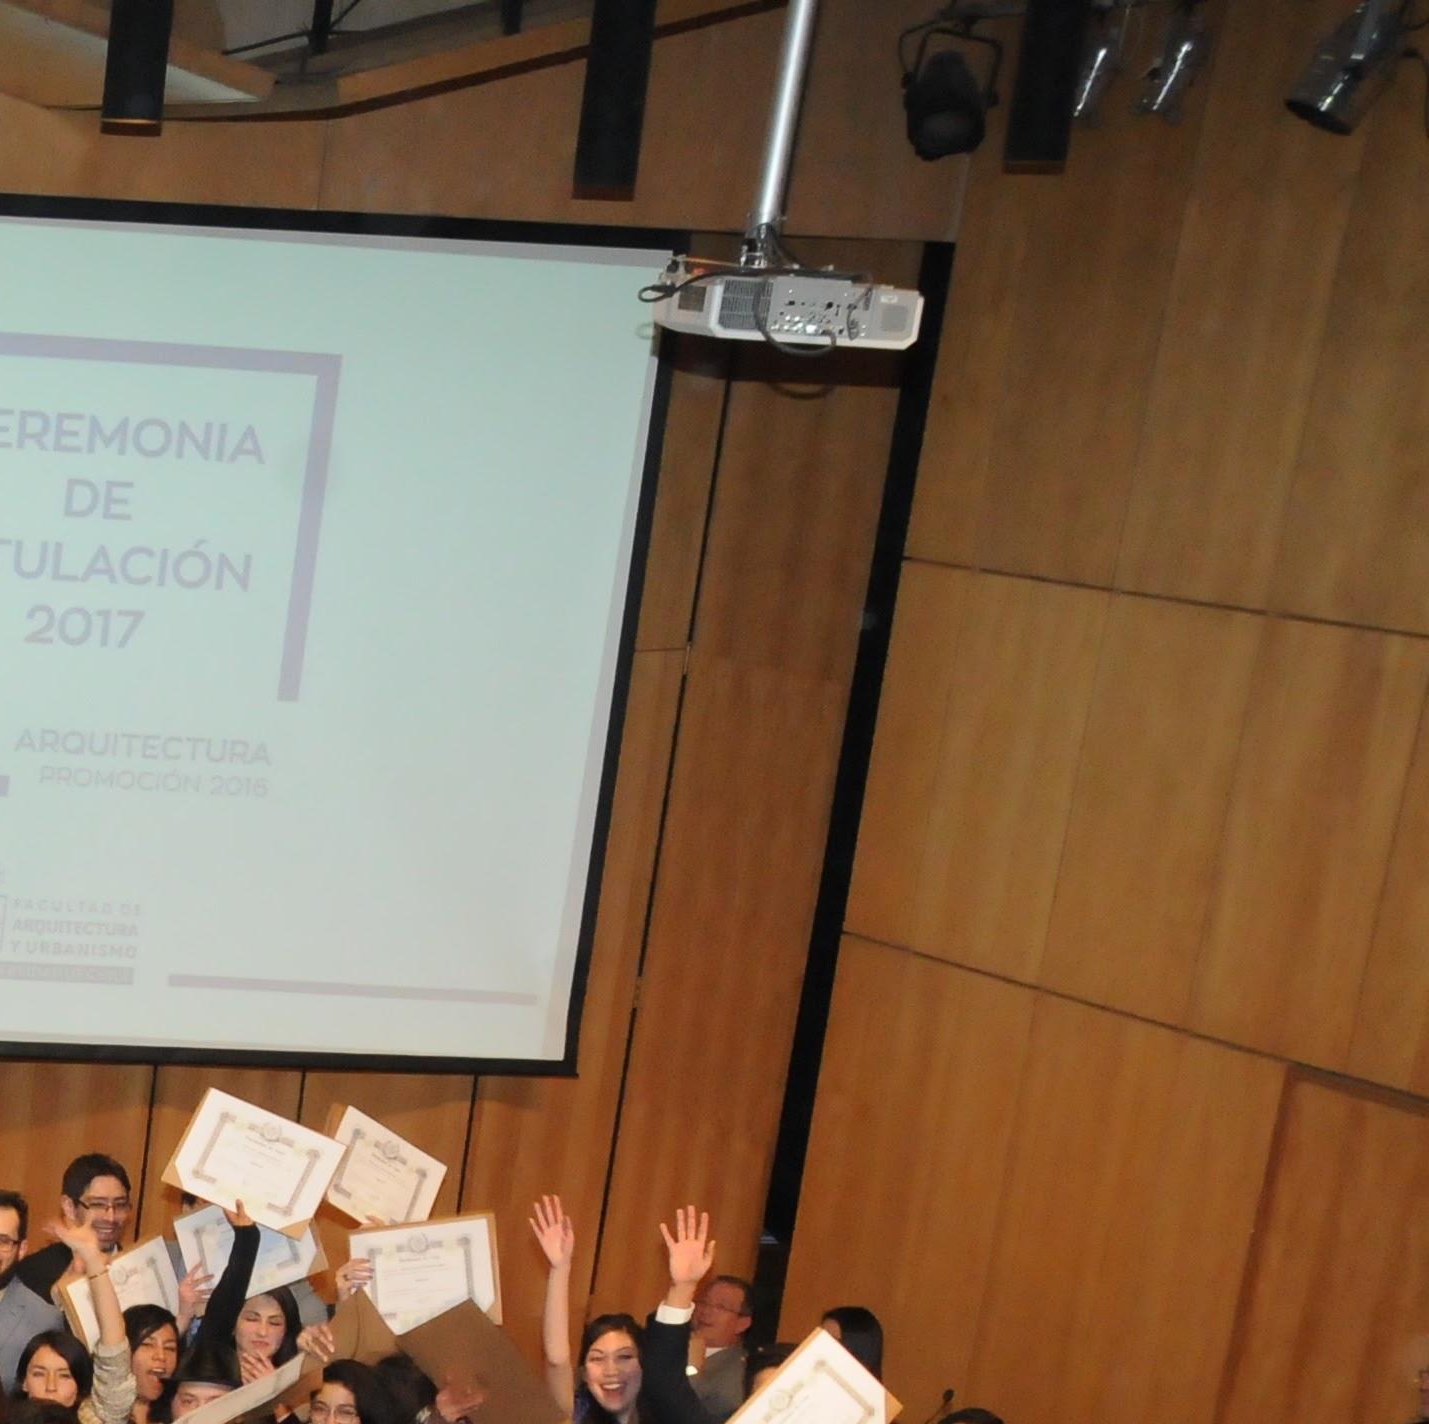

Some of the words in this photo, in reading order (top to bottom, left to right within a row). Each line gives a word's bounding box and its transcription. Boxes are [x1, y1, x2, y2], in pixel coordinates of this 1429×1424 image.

[63, 478, 134, 521] DE
[24, 603, 146, 648] 2017
[14, 728, 272, 766] ARQUITECTURA
[39, 765, 201, 794] PROMOCIÓN
[209, 774, 269, 798] 2016
[12, 918, 139, 937] ARQUITECTURA
[26, 940, 138, 959] URBANISMO
